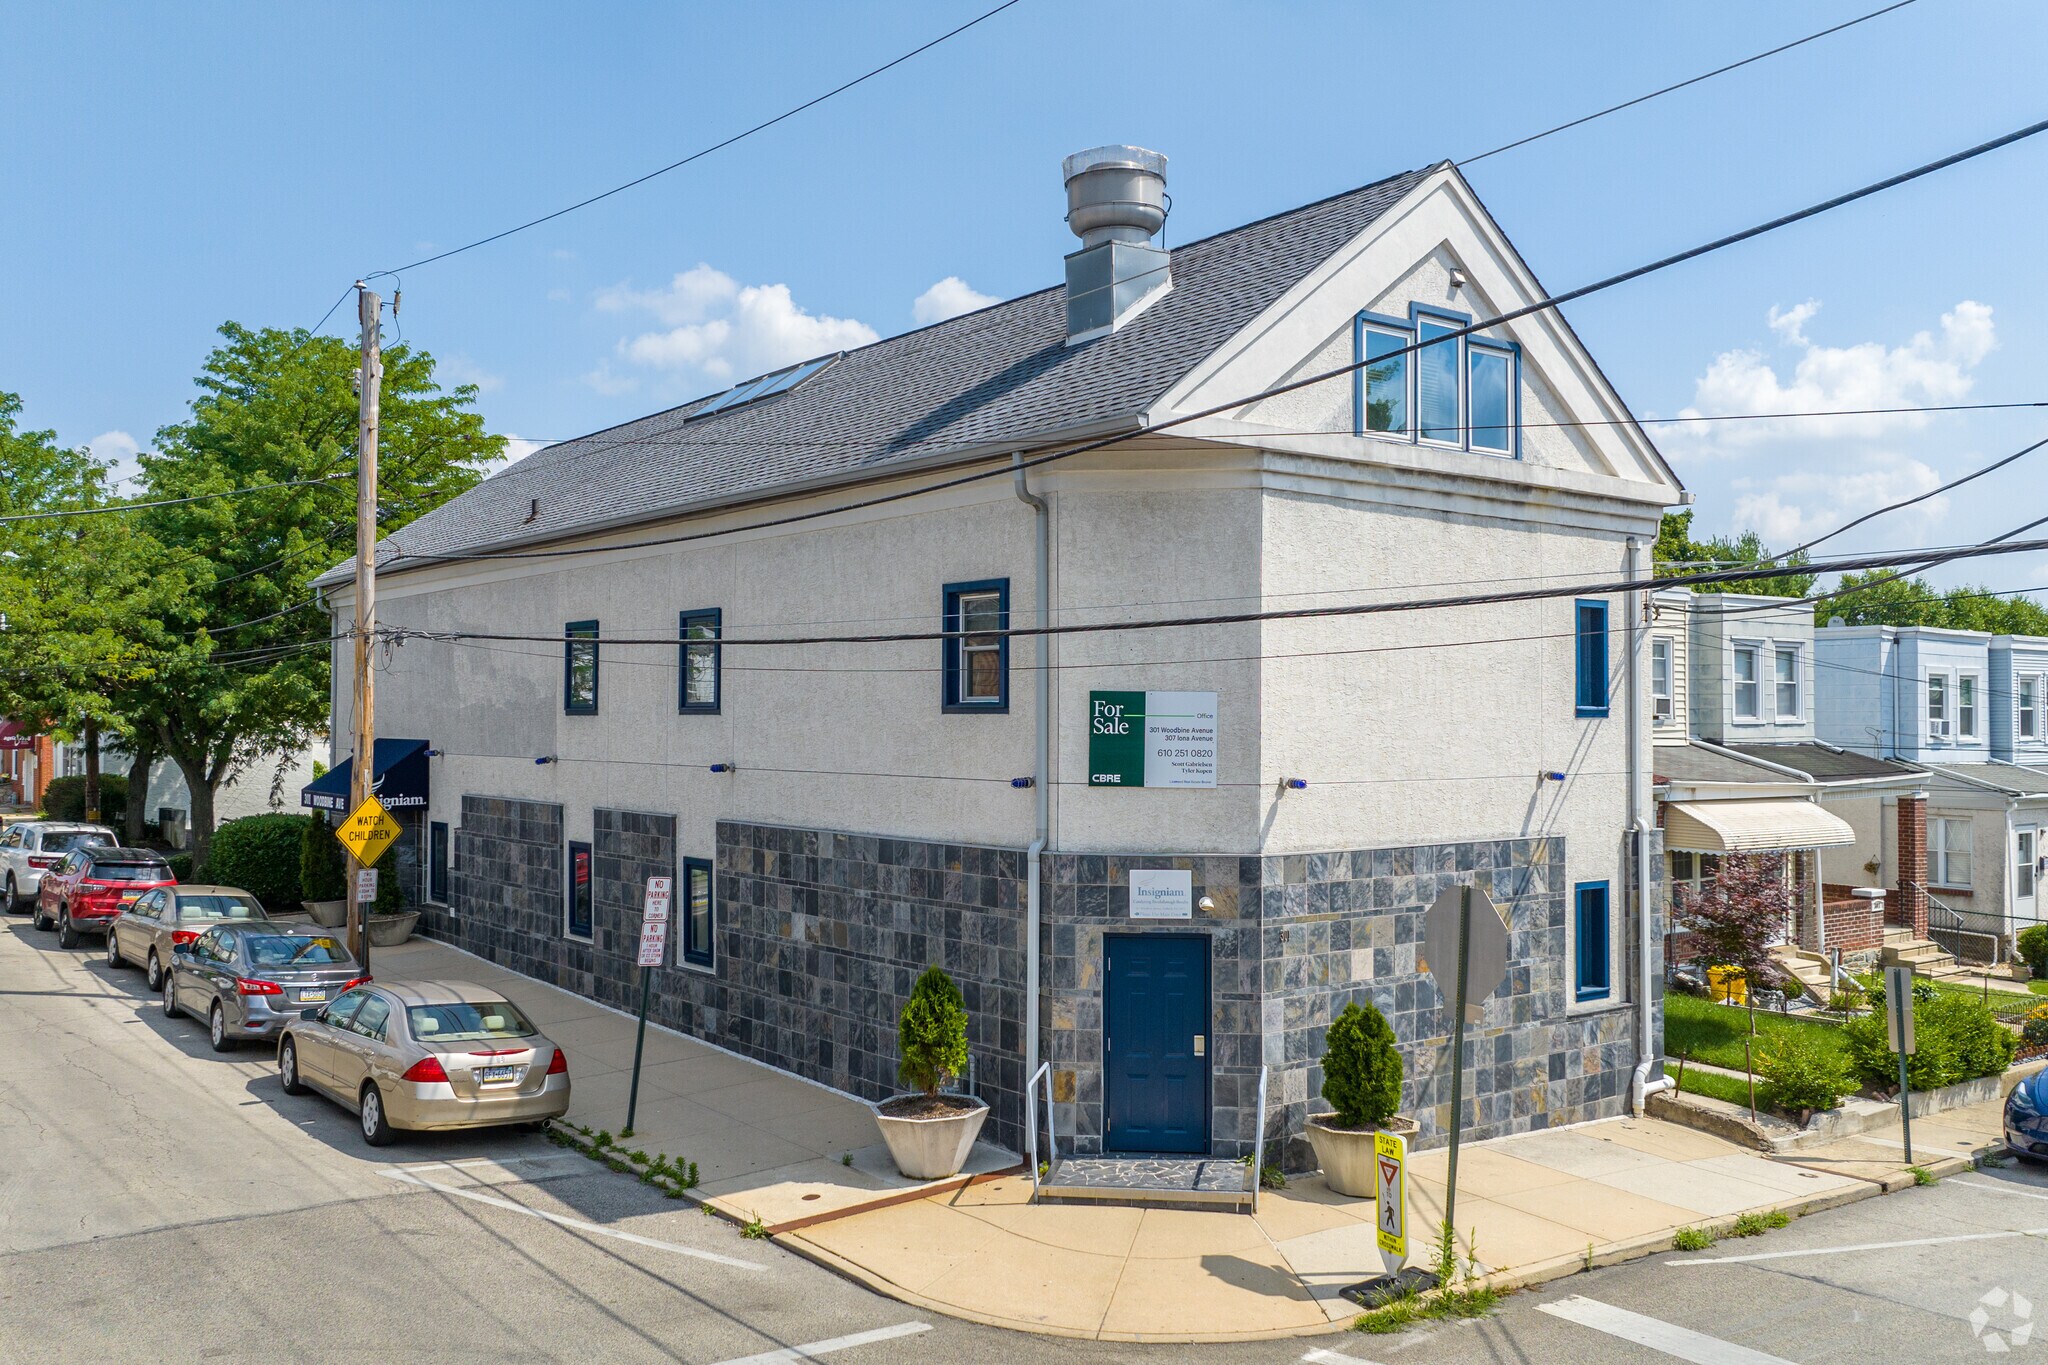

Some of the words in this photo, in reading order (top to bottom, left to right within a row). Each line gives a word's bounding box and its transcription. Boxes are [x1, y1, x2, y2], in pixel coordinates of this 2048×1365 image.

[1094, 700, 1124, 717] For
[1093, 717, 1129, 734] Sale
[1157, 749, 1173, 757] 610
[1175, 749, 1189, 757] 251
[1190, 749, 1213, 757] 0820
[1092, 774, 1121, 783] CBRE
[357, 815, 384, 826] WATCH
[349, 829, 391, 842] CHILDREN
[655, 880, 664, 889] NO
[647, 891, 669, 899] PARKING
[1137, 886, 1185, 899] Insigniam
[650, 924, 659, 933] NO
[643, 934, 664, 942] PARKING
[1379, 1135, 1398, 1149] STATE
[1382, 1146, 1395, 1156] LAW
[1383, 1234, 1398, 1244] WITHIN
[1379, 1239, 1402, 1253] CROSSWALK
